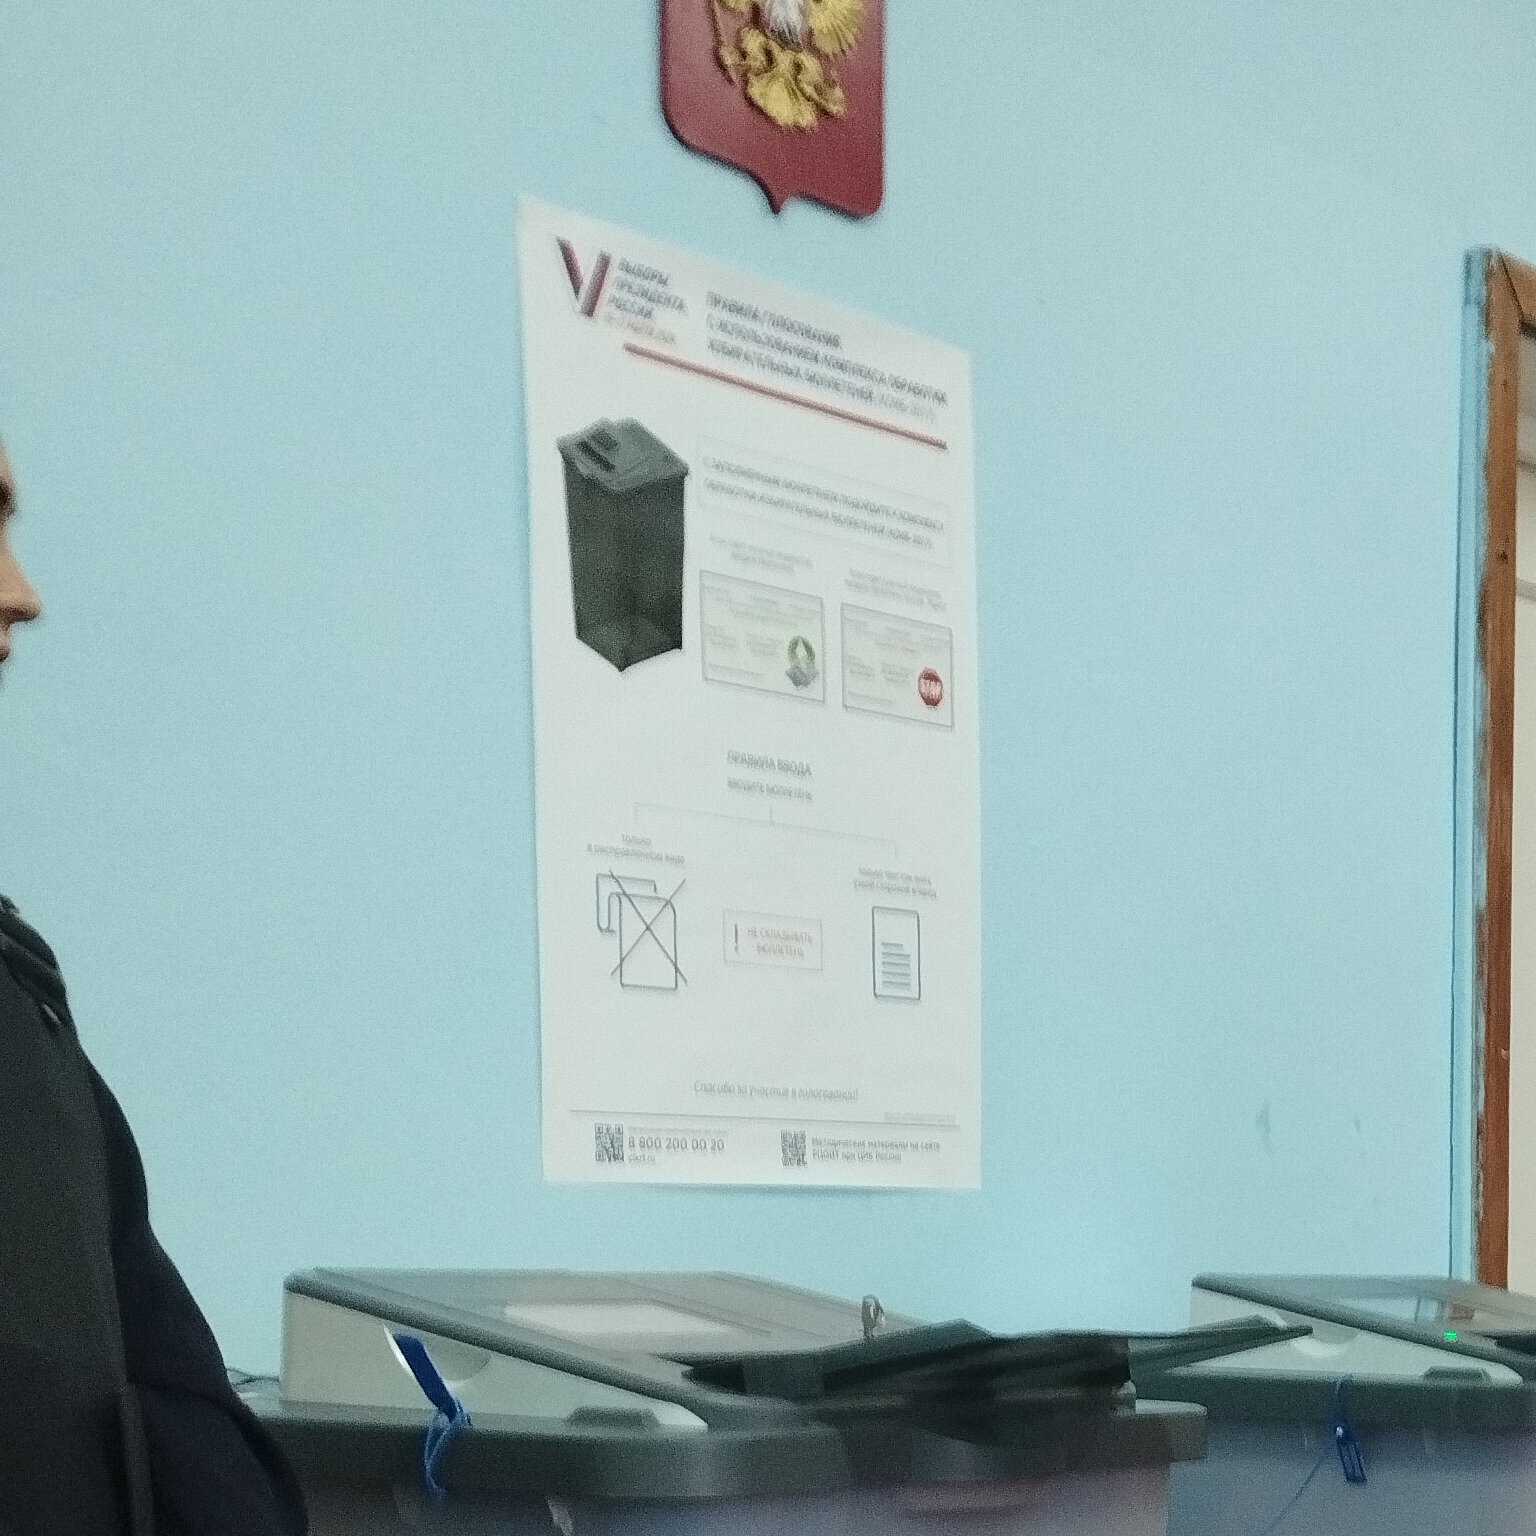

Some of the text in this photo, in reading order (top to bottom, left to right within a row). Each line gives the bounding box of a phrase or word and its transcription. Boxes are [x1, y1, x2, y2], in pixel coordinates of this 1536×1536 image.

[618, 256, 670, 287] ВЫБОРЫ
[607, 291, 653, 321] РОССИИ
[612, 273, 685, 313] ПРЕЗИДЕНТА
[706, 289, 841, 350] ПРАВИЛА ГОЛОСОВАНИЯ
[726, 748, 812, 778] ПРАВИЛА ВВОДА
[747, 924, 812, 945] НЕ СКЛАДЫВАТЬ
[693, 1079, 736, 1096] Спасибо
[748, 1085, 789, 1100] участие
[665, 1136, 687, 1150] 200
[691, 1137, 707, 1151] 00
[710, 1137, 724, 1151] 20
